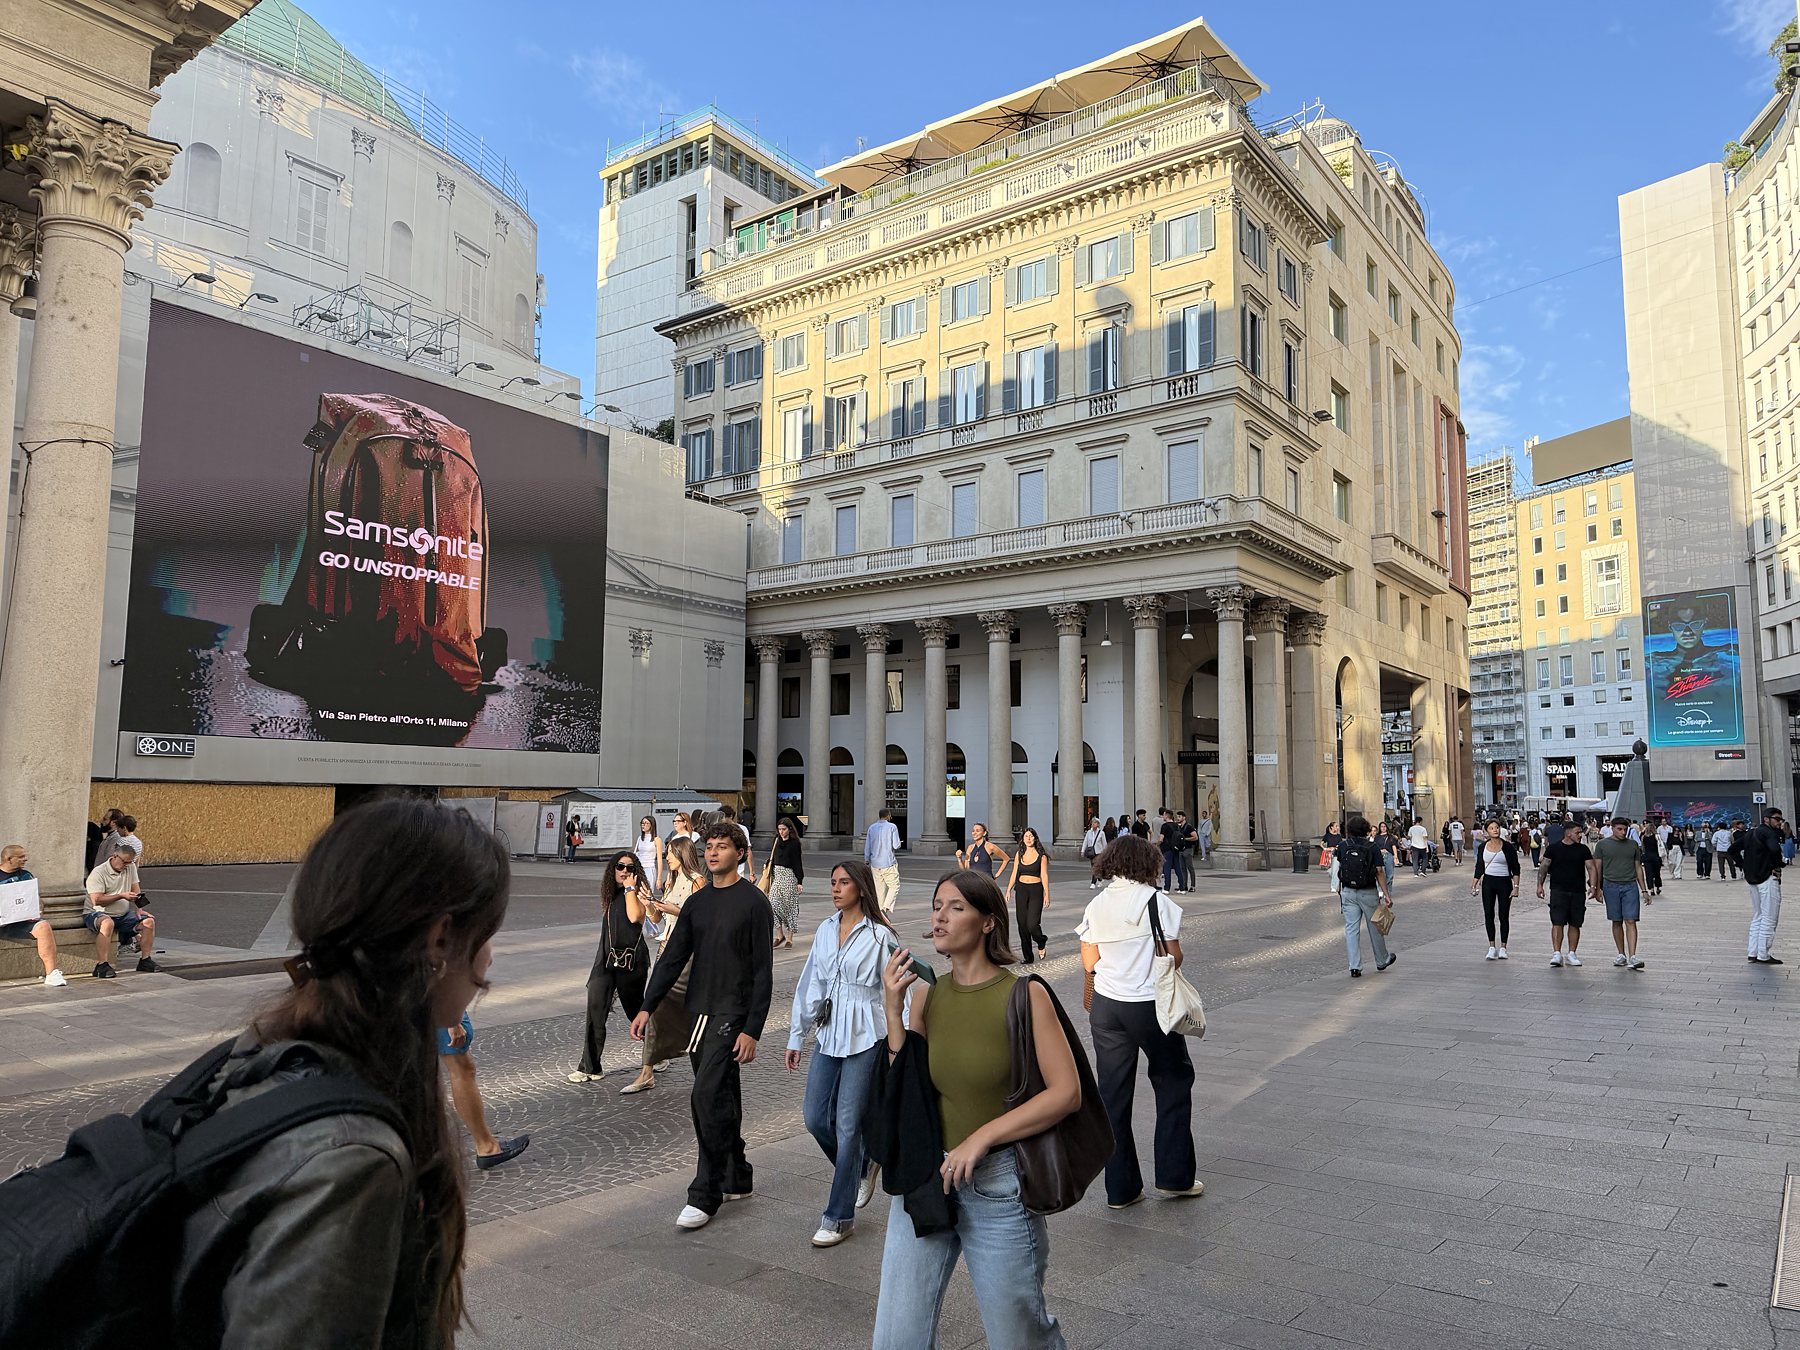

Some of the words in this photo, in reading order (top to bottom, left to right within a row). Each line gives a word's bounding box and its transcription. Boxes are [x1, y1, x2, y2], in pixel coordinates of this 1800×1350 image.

[324, 510, 483, 561] Samsonite
[319, 551, 350, 569] GO
[353, 556, 481, 590] UNSTOPPABLE
[318, 710, 335, 719] Via
[337, 711, 357, 720] San
[359, 713, 388, 723] Pietro
[389, 715, 424, 725] all'Orto
[425, 718, 437, 727] 11,
[438, 718, 468, 728] Milano
[157, 740, 194, 753] ONE
[1547, 765, 1576, 774] SPADA
[1602, 763, 1627, 772] SPAD
